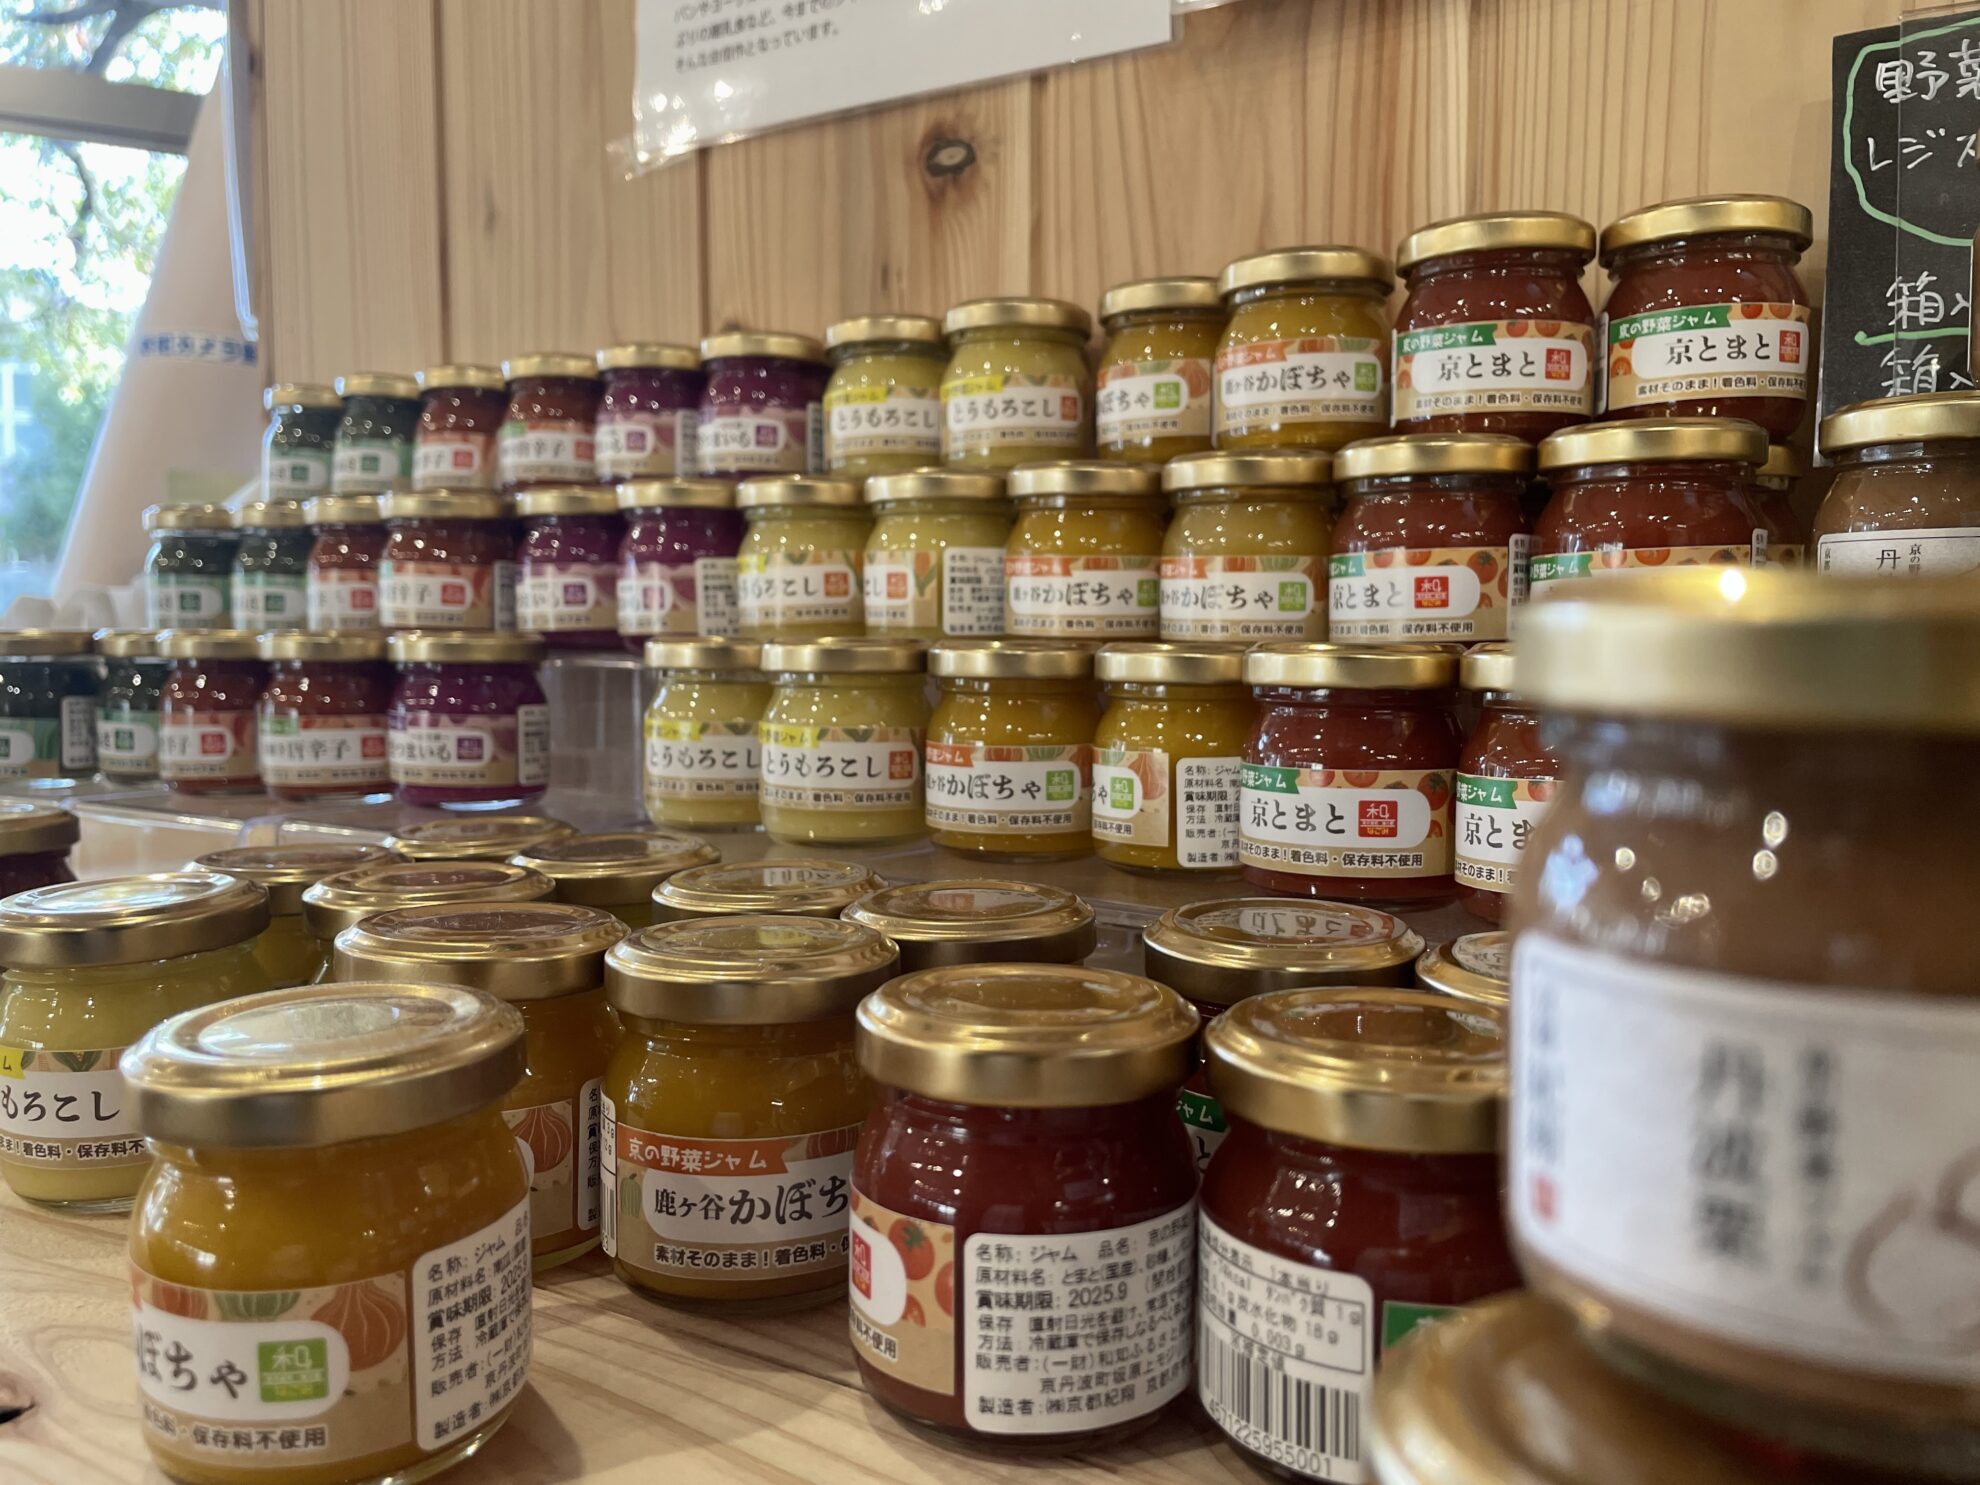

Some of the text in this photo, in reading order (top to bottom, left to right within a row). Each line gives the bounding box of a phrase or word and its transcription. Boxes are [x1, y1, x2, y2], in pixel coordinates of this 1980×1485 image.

[1619, 311, 1718, 339] 京の野菜ジャム
[1402, 329, 1484, 354] 京の野菜ジャム
[1666, 332, 1771, 365] 京とまと
[1438, 351, 1536, 381] 京とまと
[953, 398, 1056, 424] とうもろこし
[1332, 580, 1404, 610] 京とまと
[1420, 579, 1442, 591] 和
[765, 750, 882, 778] とうもろこし
[1251, 798, 1347, 835] 京とまと
[1366, 804, 1390, 818] 和
[1, 1084, 121, 1122] もろこし
[628, 1138, 768, 1172] 京の野菜ジャム
[979, 1314, 1014, 1332] 保存
[978, 1333, 1013, 1351] 方法
[272, 1344, 313, 1371] 和
